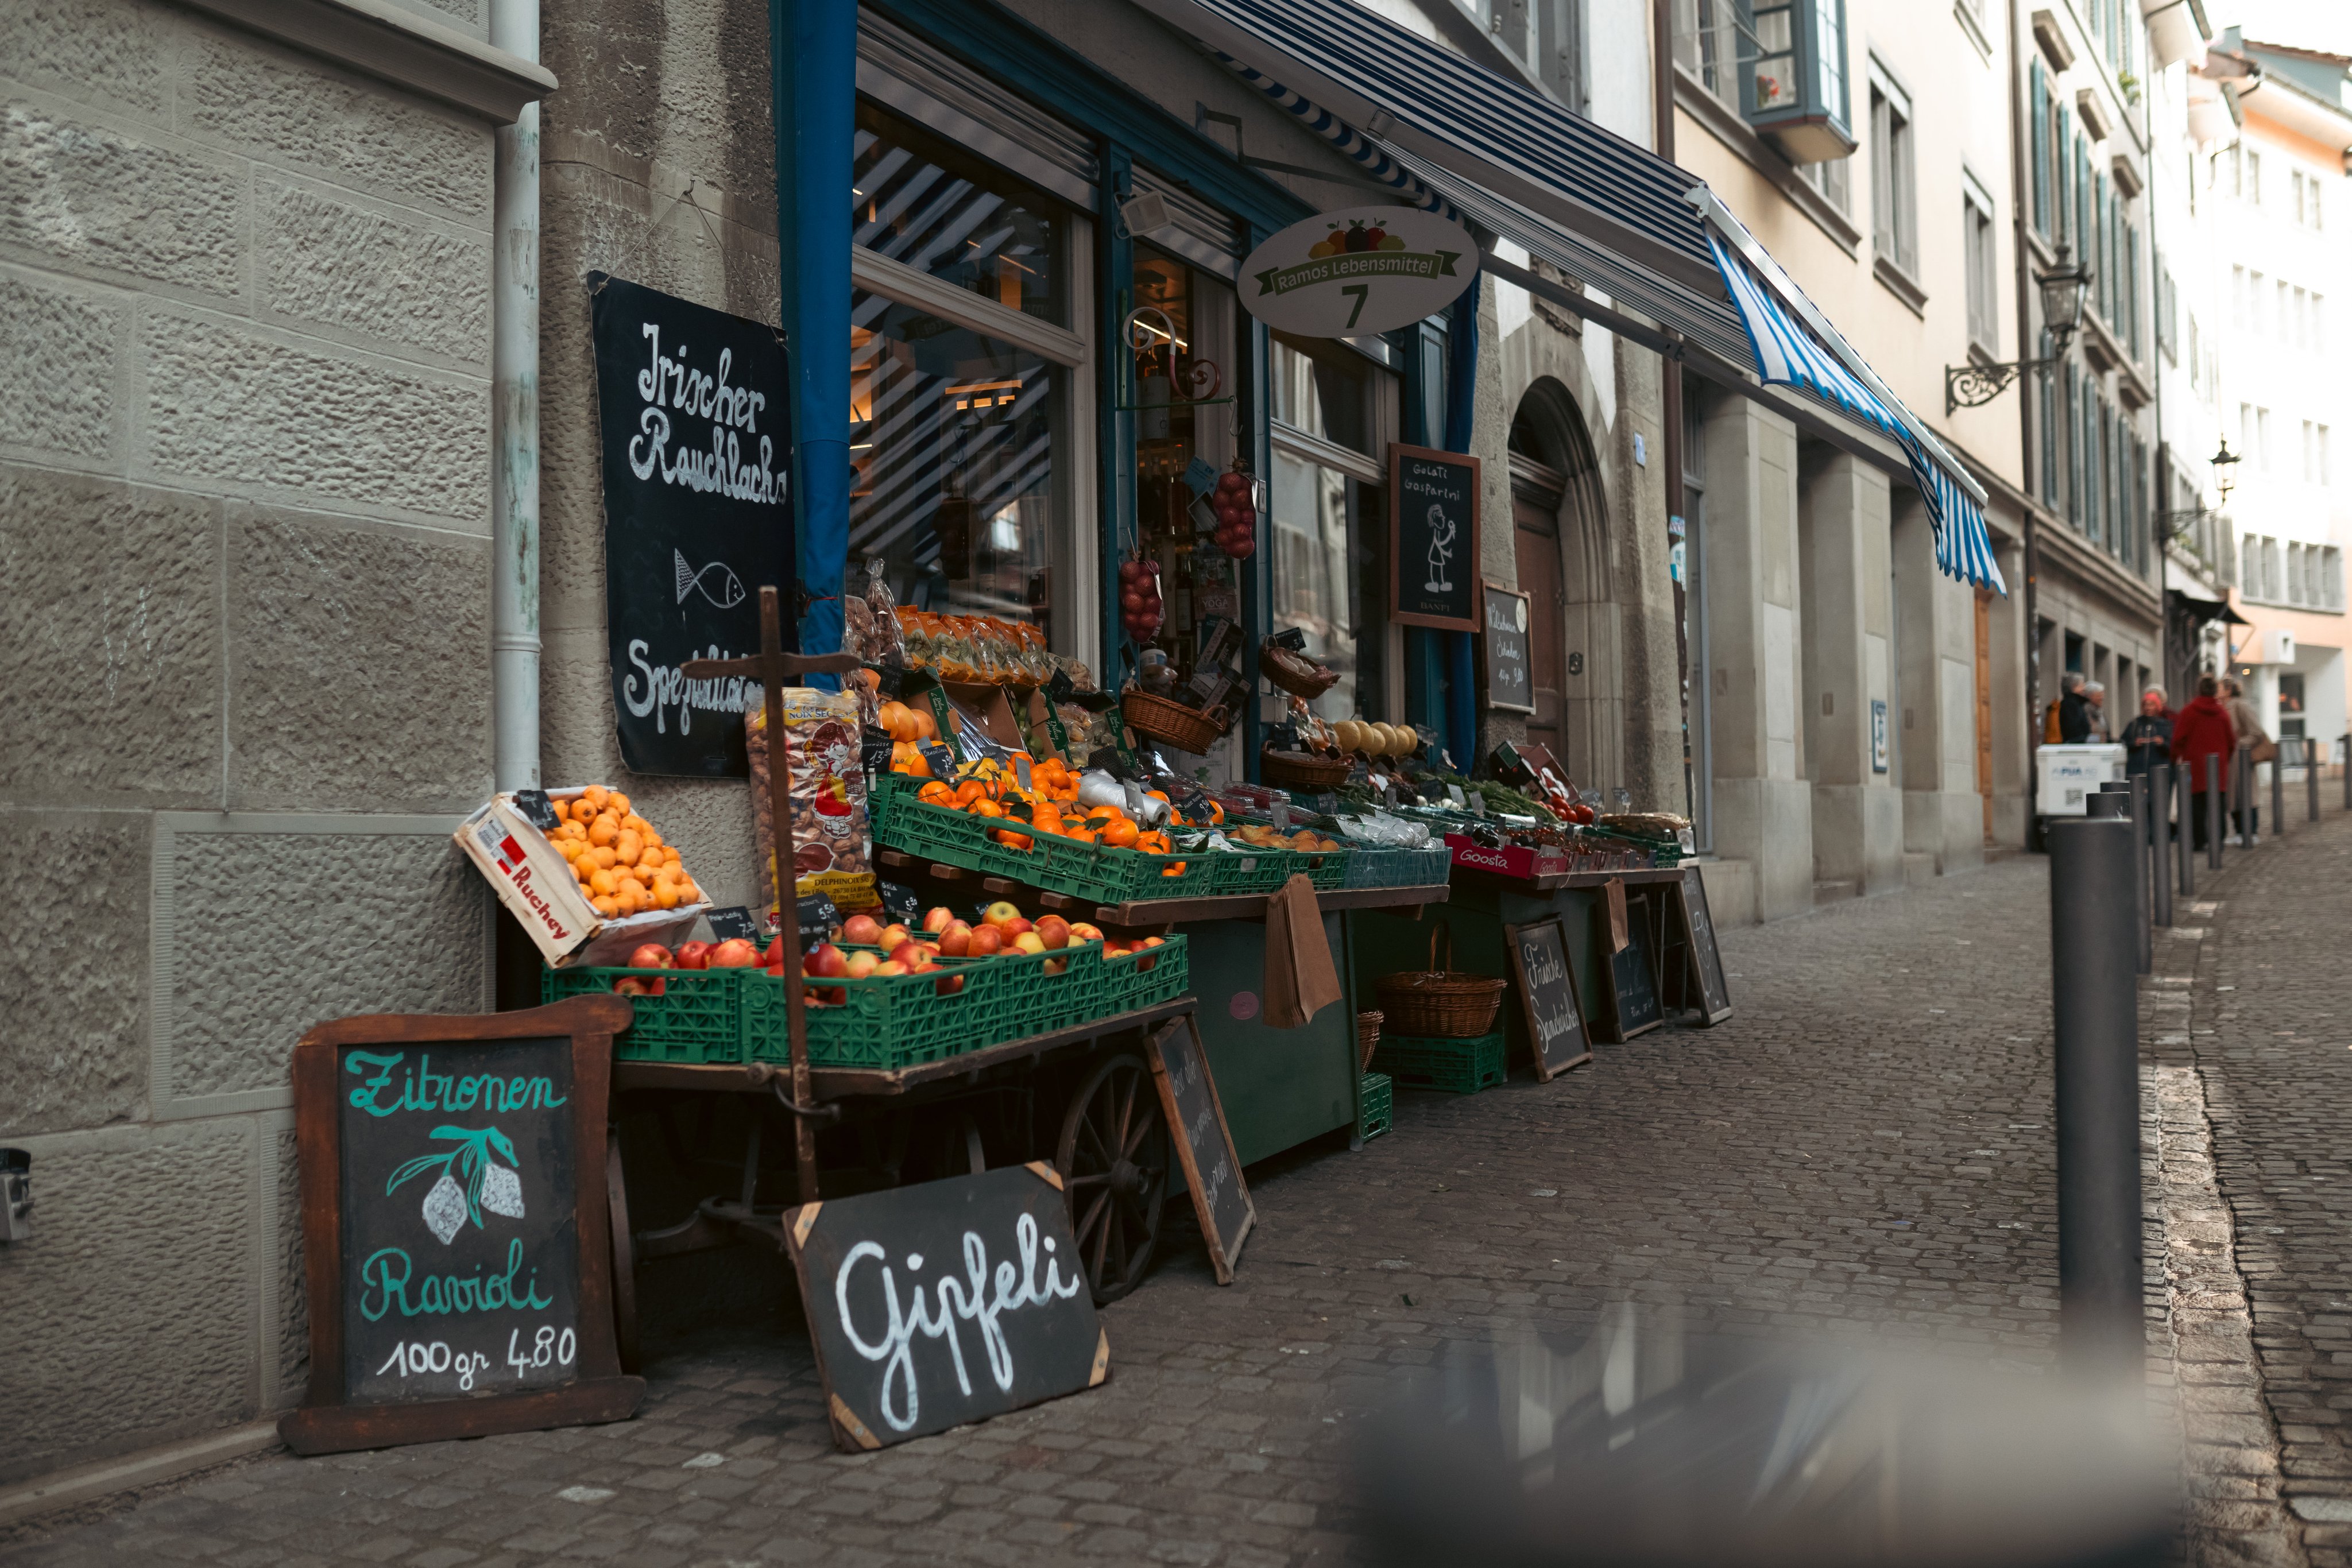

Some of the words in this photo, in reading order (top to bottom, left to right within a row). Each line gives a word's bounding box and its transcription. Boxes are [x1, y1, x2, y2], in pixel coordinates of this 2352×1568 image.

[1278, 265, 1328, 290] Ramos
[1333, 257, 1433, 274] Lebensmittel
[1341, 284, 1369, 330] 7
[1413, 463, 1447, 479] Gelati
[1405, 479, 1460, 501] Gasparini
[1202, 598, 1228, 608] YOGA
[788, 711, 813, 719] NOIX
[869, 748, 892, 766] 13.90
[1460, 849, 1508, 869] Goosta
[814, 877, 860, 886] DELPHINOIX
[881, 882, 898, 891] Gala
[512, 866, 571, 940] Ruchey
[818, 904, 835, 920] 5.50
[906, 897, 917, 911] 5.90
[1524, 943, 1563, 990] Frische
[1530, 992, 1580, 1055] Sandwiches
[345, 1051, 567, 1117] Zitronen
[360, 1238, 554, 1322] Ravioli
[835, 1212, 1080, 1432] Gipfeli
[508, 1325, 577, 1379] 4.80
